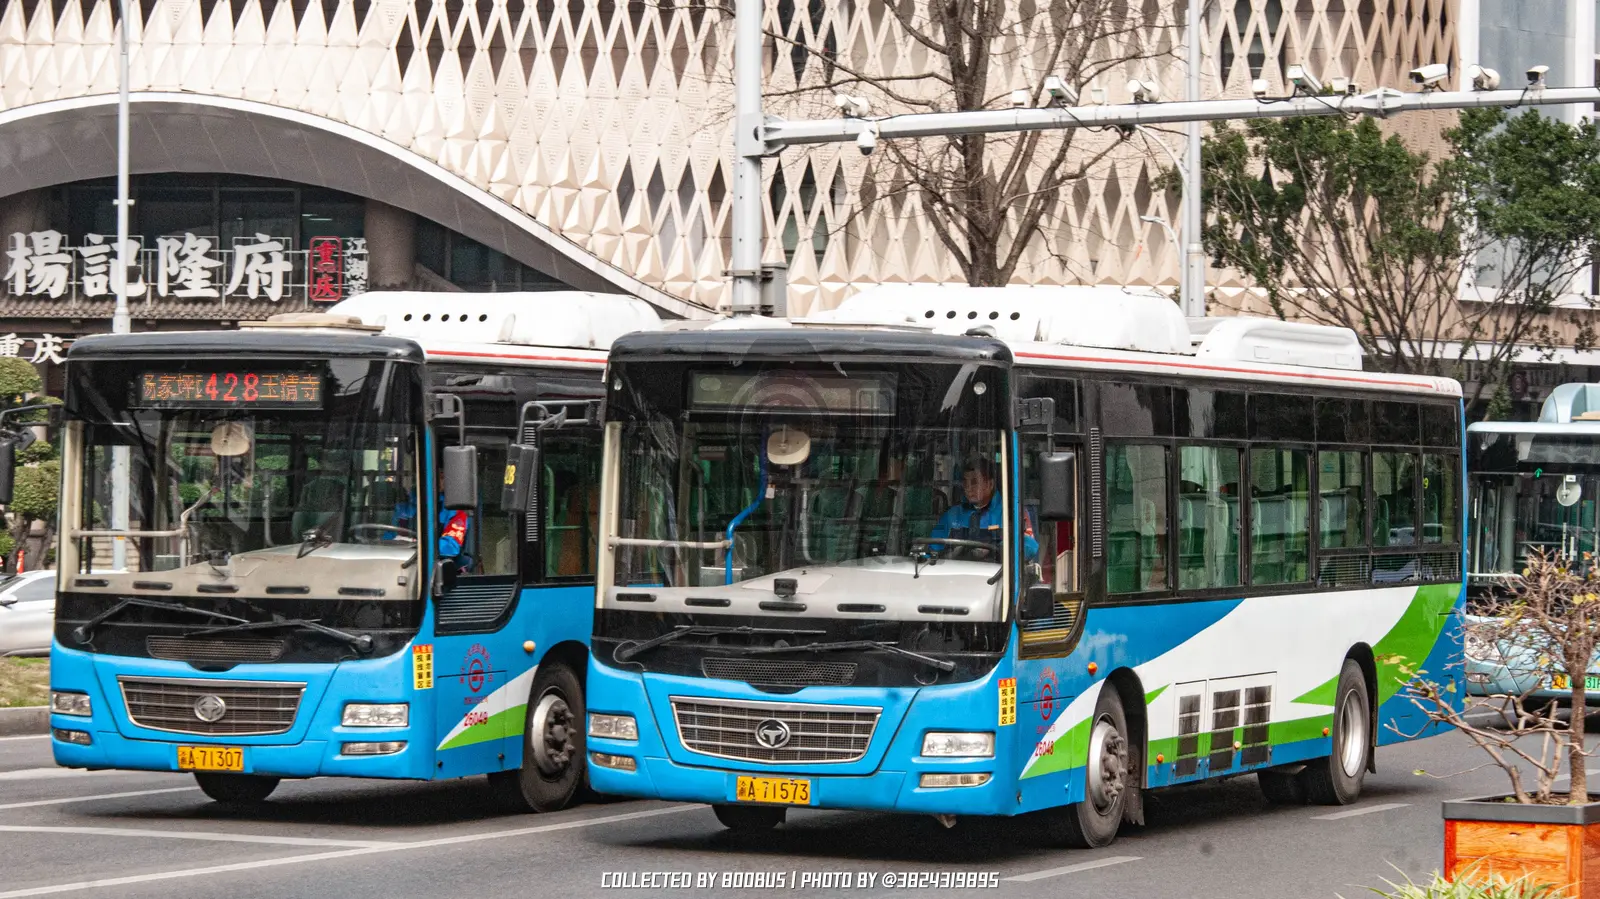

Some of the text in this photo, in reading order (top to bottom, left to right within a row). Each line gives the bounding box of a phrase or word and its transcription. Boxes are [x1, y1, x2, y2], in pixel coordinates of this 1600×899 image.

[3, 230, 293, 301] 楊記隆府
[313, 240, 338, 297] 重庆
[0, 332, 68, 364] 重庆
[205, 373, 259, 401] 428
[259, 373, 321, 401] 玉清寺
